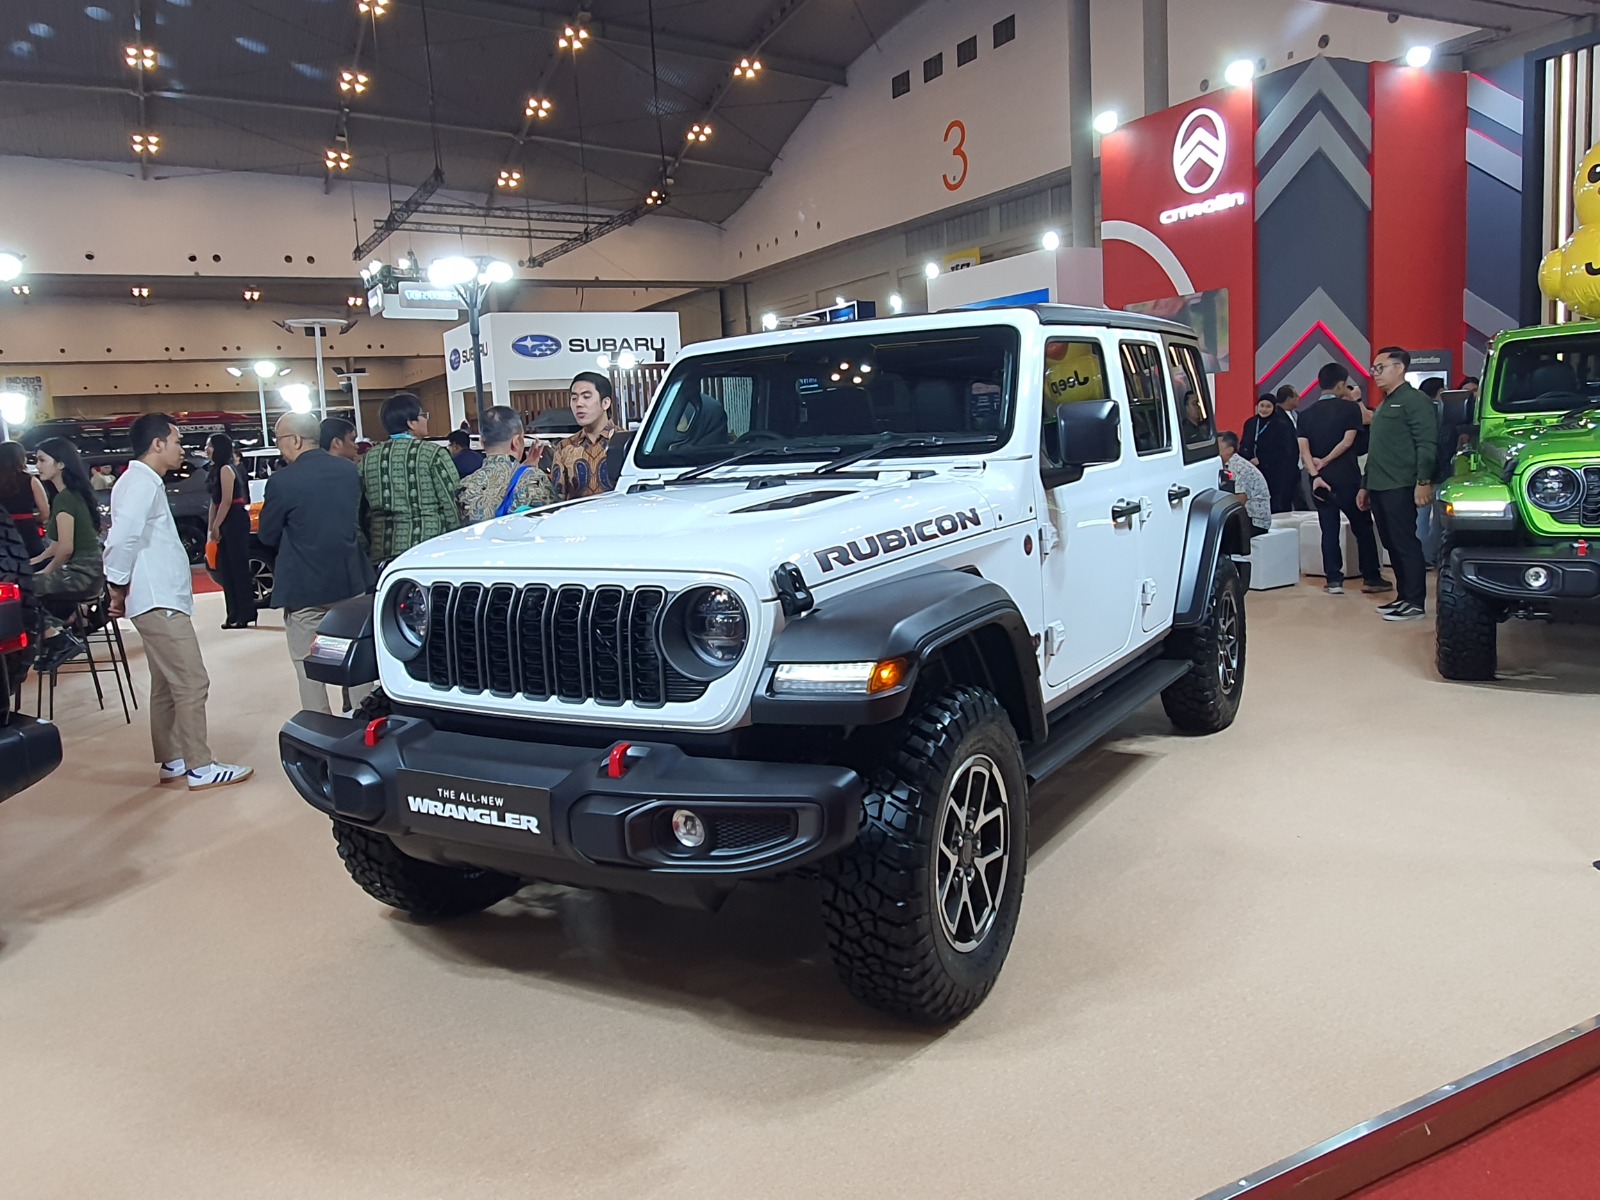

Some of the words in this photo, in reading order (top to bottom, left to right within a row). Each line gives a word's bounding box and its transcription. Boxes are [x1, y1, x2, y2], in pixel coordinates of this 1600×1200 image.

[942, 119, 968, 191] 3
[462, 341, 489, 363] SUBRU
[568, 337, 665, 352] SUBARU
[813, 507, 982, 573] RUBICON
[437, 788, 456, 800] THE
[459, 792, 504, 807] ALL-NEW
[407, 796, 542, 835] WRANGLER
